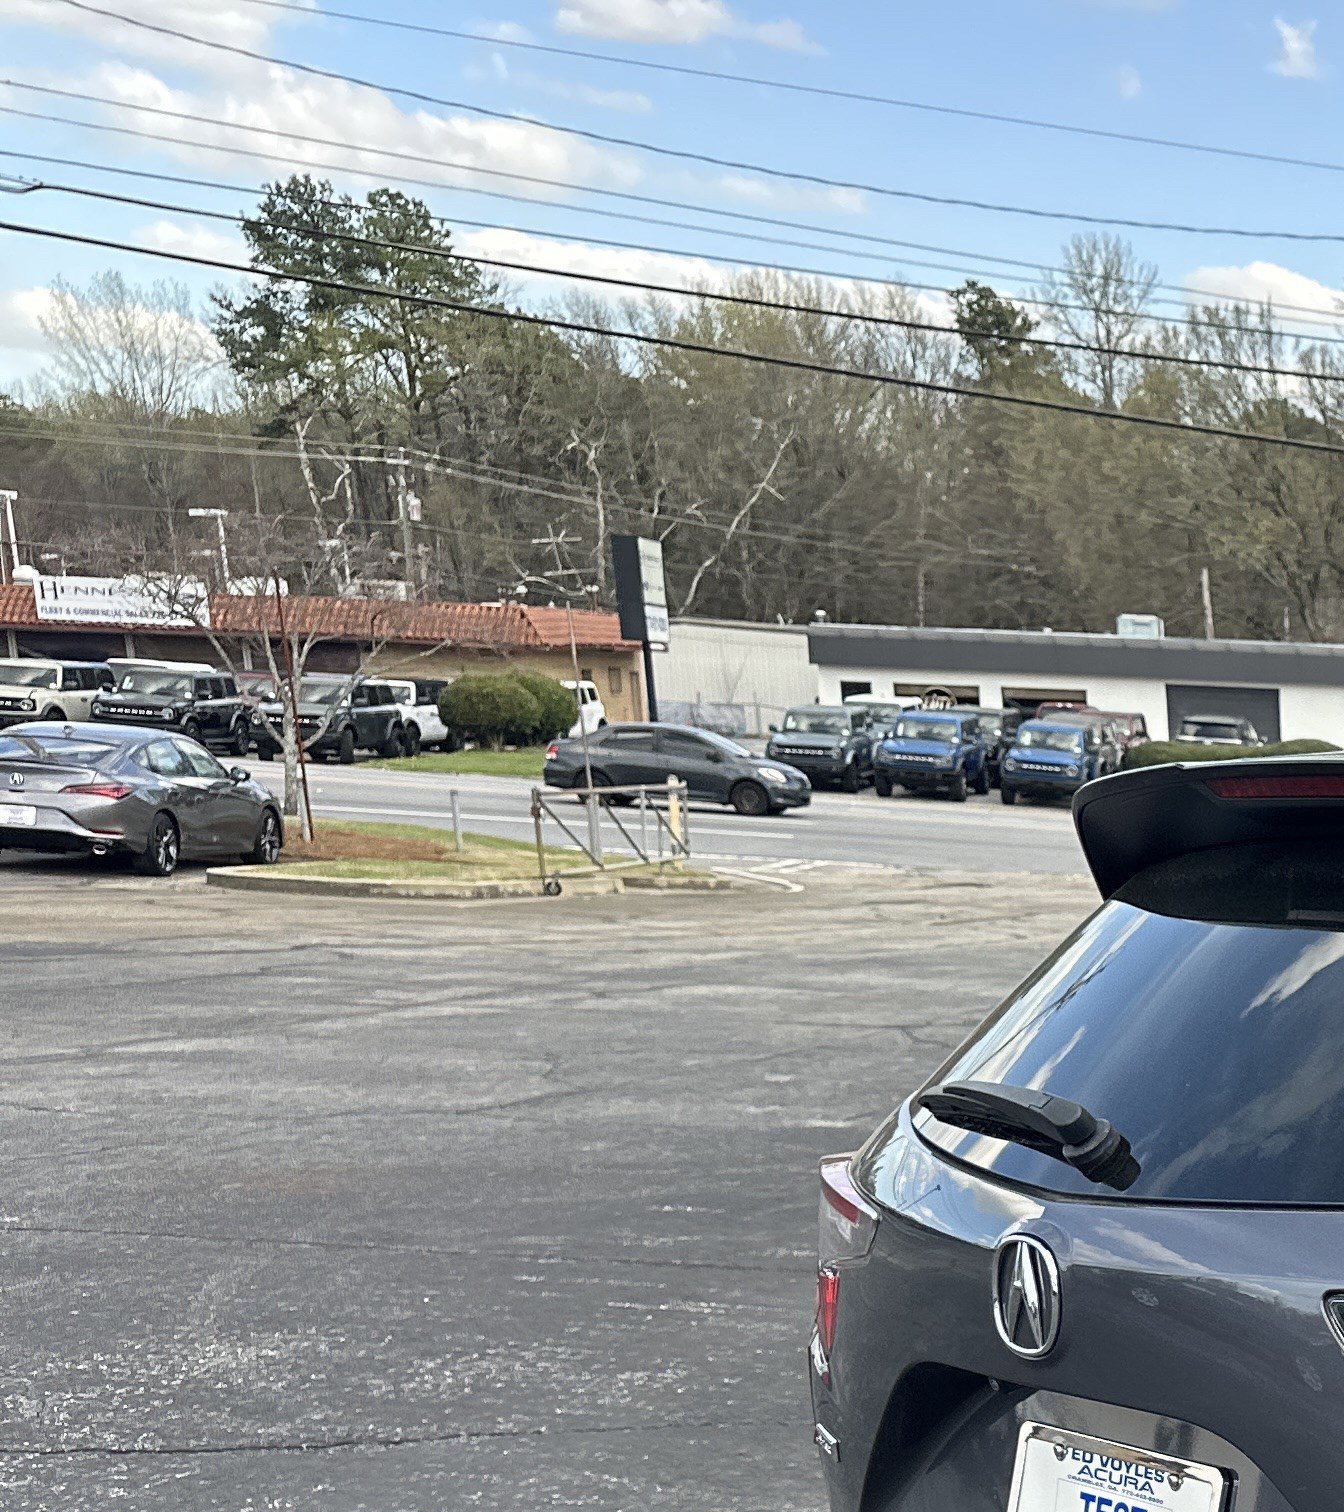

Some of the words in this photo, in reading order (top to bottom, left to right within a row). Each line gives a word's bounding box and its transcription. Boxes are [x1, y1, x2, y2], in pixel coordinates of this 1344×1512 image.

[1071, 1448, 1094, 1464] ED
[1100, 1455, 1165, 1483] VOYLES
[1077, 1464, 1155, 1495] ACURA
